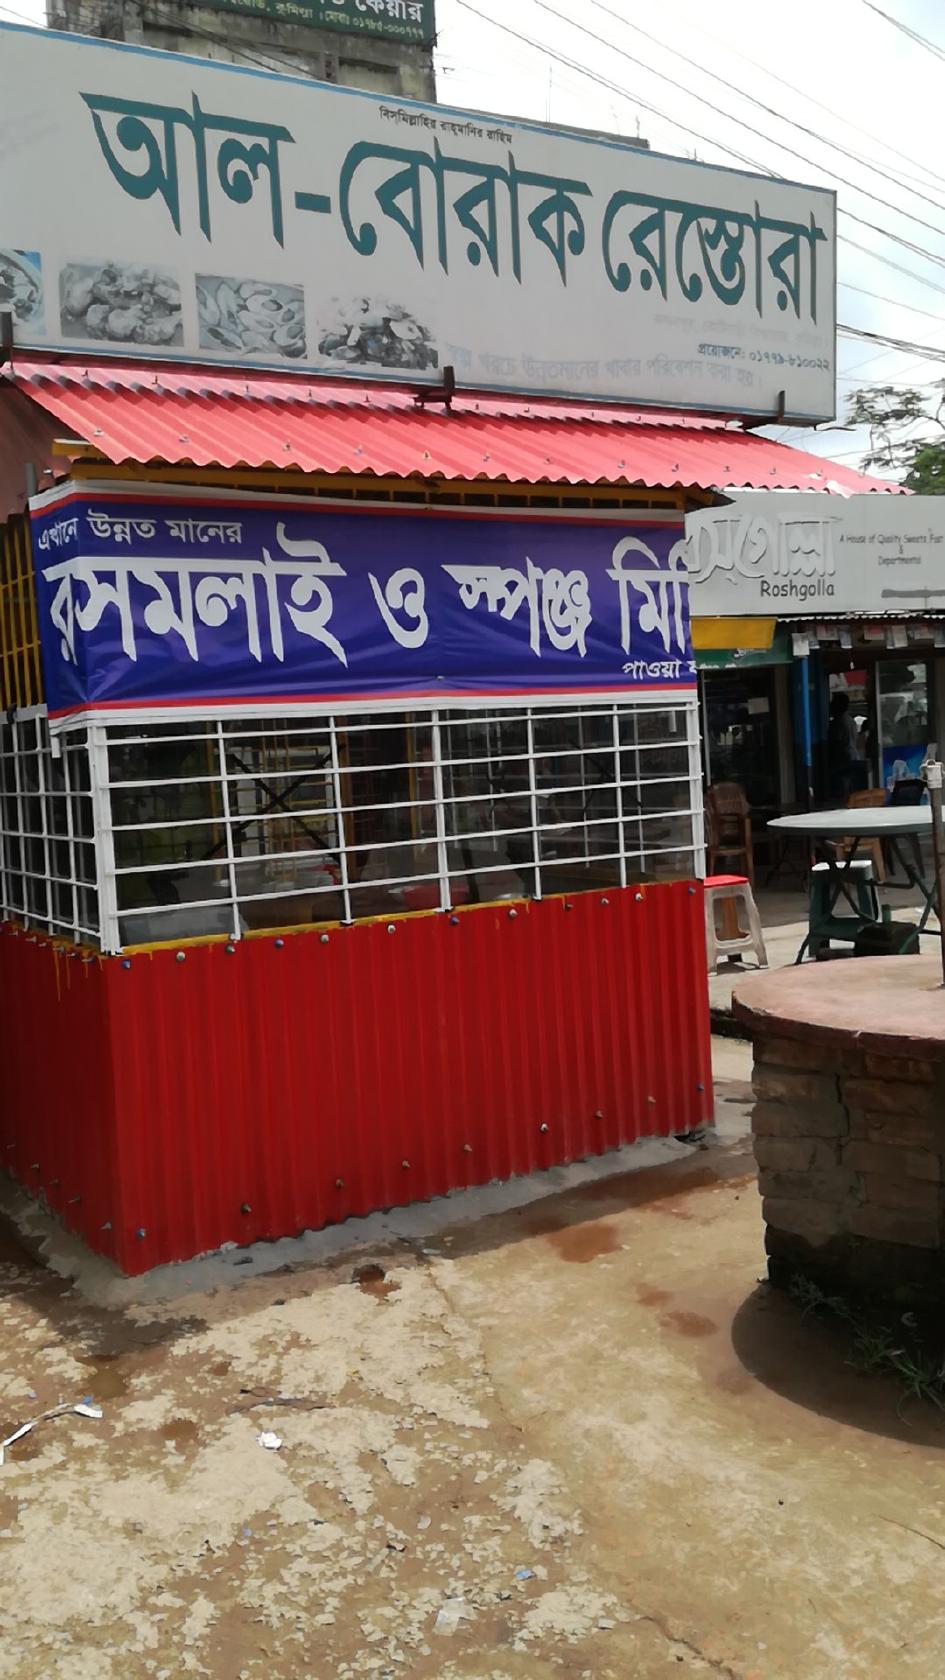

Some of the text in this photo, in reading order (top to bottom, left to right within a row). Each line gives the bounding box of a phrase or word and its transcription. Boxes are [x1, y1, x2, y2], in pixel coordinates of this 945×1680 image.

[602, 189, 828, 325] রেস্তোরা
[38, 508, 242, 550] এখানে উন্নত মানের
[42, 521, 347, 668] রসমলাই
[368, 567, 429, 649] ও
[761, 580, 835, 601] Roshgolla
[622, 658, 682, 680] পাওয়া
